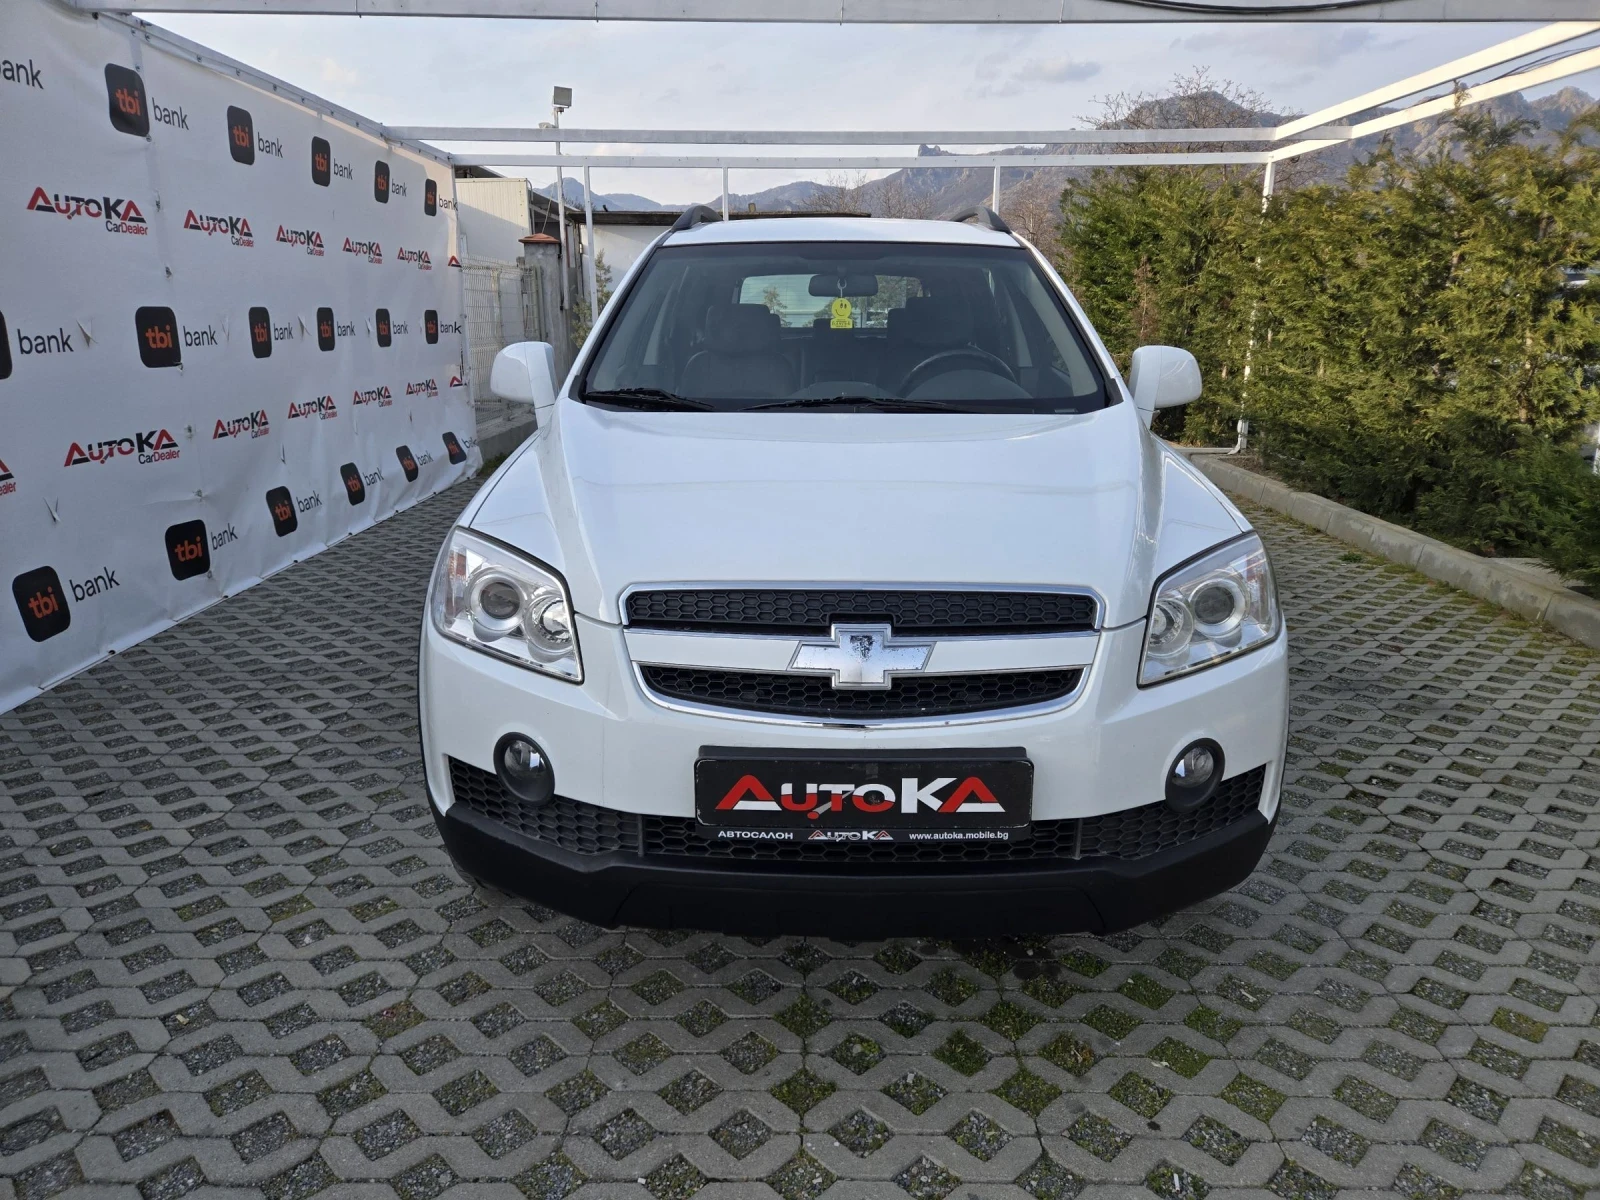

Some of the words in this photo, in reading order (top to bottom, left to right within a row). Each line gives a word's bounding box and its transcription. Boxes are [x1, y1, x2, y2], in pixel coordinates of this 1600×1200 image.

[0, 59, 44, 90] ank
[115, 88, 141, 117] tbi
[152, 97, 189, 130] bank
[233, 125, 250, 148] tbi
[258, 132, 283, 158] bank
[315, 152, 327, 173] tbi
[333, 158, 353, 181] bank
[377, 174, 387, 191] tbi
[391, 178, 407, 197] bank
[427, 191, 435, 205] tbi
[438, 195, 458, 212] bank
[105, 220, 149, 236] CarDealer
[145, 325, 173, 349] tbi
[183, 325, 218, 347] bank
[254, 321, 268, 342] tbi
[273, 322, 294, 341] bank
[320, 321, 332, 338] tbi
[337, 321, 356, 337] bank
[379, 321, 389, 336] tbi
[393, 320, 408, 335] bank
[426, 321, 437, 334] tbi
[440, 321, 462, 335] bank
[17, 328, 74, 355] bank
[138, 449, 180, 465] CarDealer
[403, 455, 415, 471] tbi
[415, 450, 434, 466] bank
[347, 474, 362, 492] tbi
[274, 500, 292, 522] tbi
[295, 490, 322, 513] bank
[174, 536, 203, 562] tbi
[210, 523, 238, 550] bank
[28, 586, 59, 619] tbi
[69, 566, 120, 602] bank
[715, 774, 1006, 820] AUTOKA
[718, 830, 793, 840] АВТОСАЛОН
[909, 830, 1009, 841] www.autoka.mobile.bg
